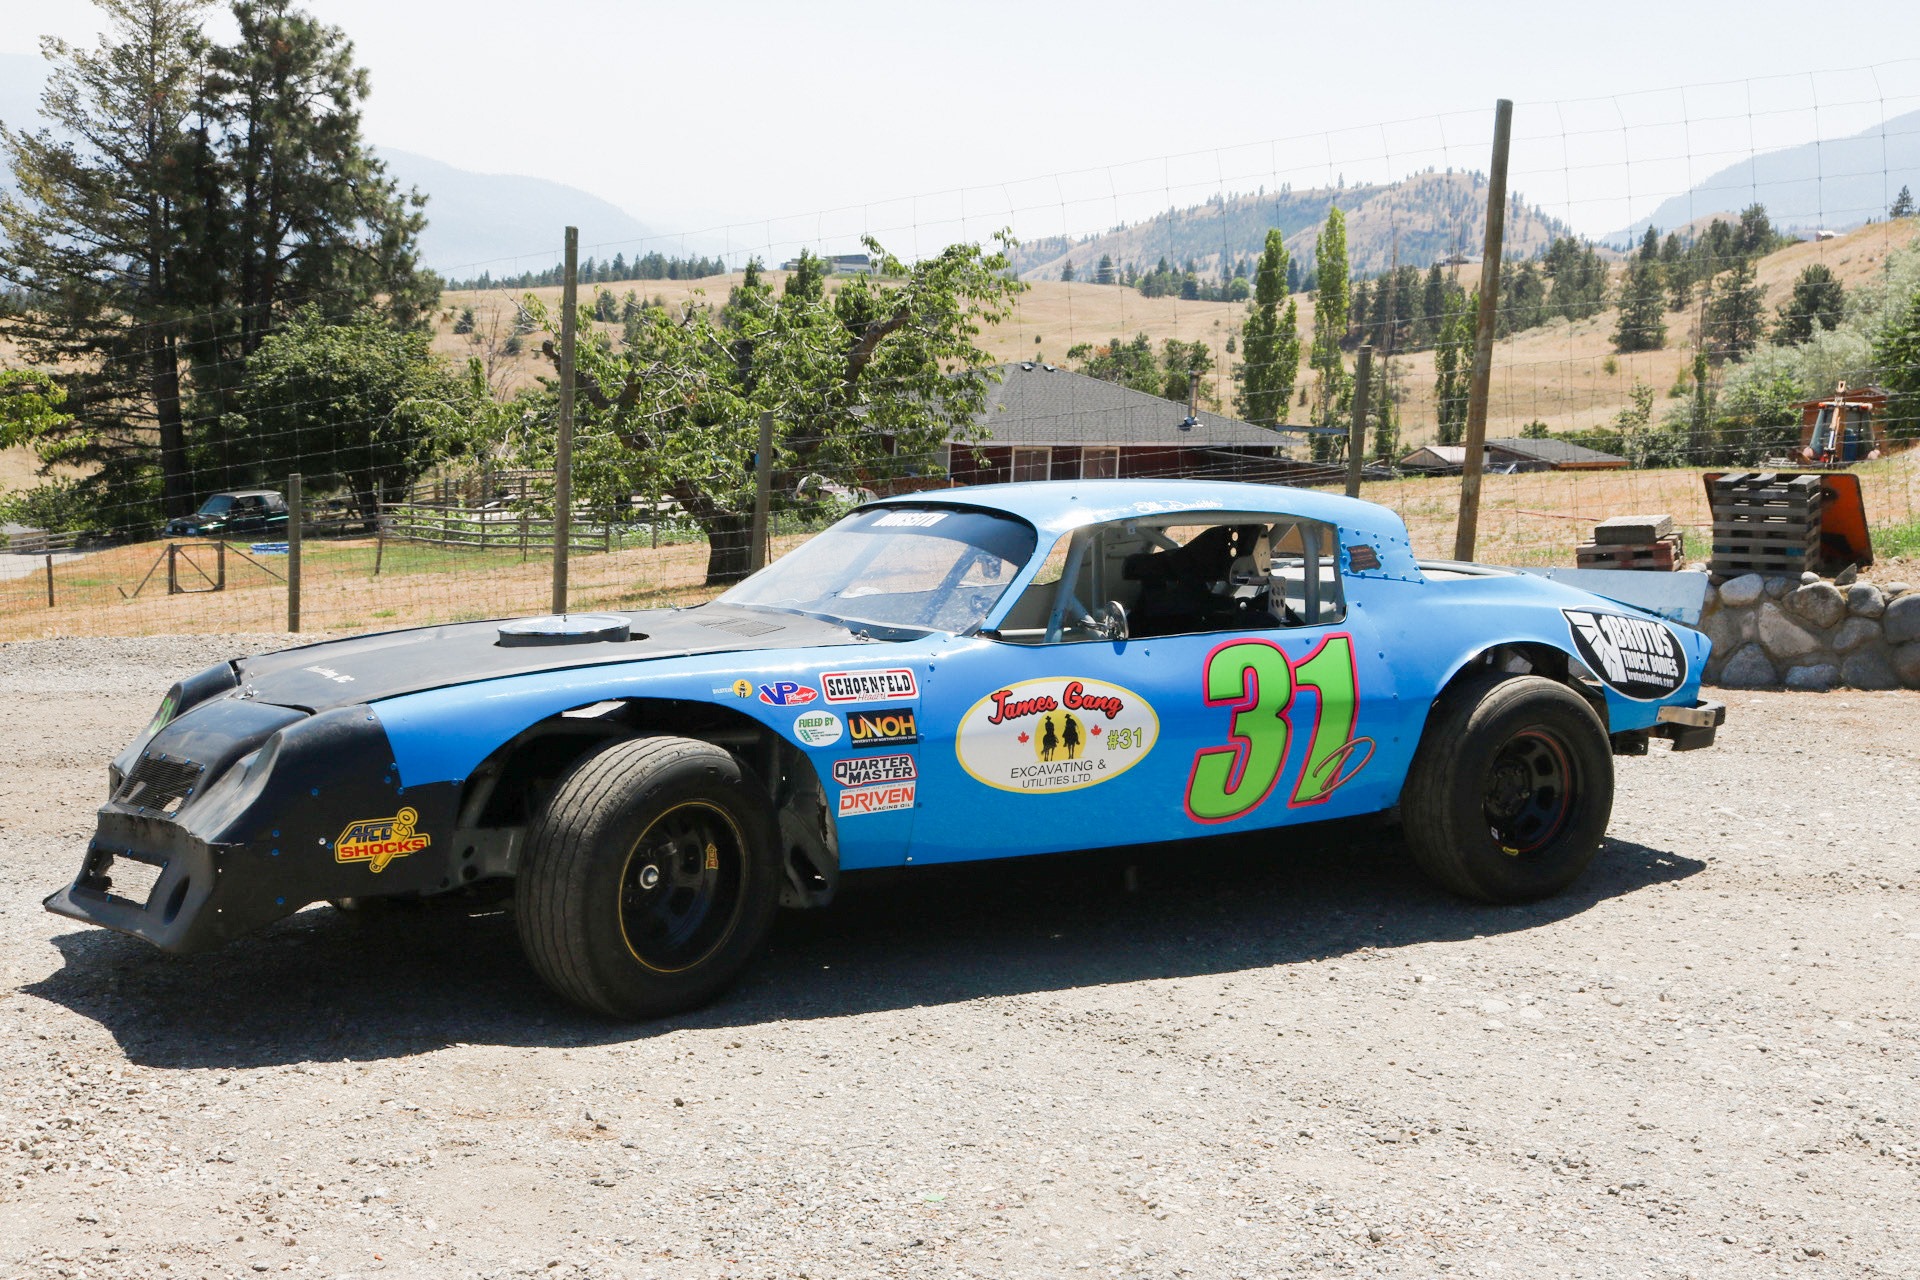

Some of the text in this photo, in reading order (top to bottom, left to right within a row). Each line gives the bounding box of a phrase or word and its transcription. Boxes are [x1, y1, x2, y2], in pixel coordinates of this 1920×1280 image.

[1608, 615, 1674, 657] BRUTUS
[1620, 650, 1679, 677] TRUCK BODIES
[760, 682, 798, 705] VP
[828, 674, 911, 696] SCHOENFELD
[857, 691, 887, 702] Headers
[988, 681, 1124, 725] James Gang
[798, 717, 834, 728] FUELED BY
[848, 714, 917, 739] UNOH
[1184, 632, 1360, 824] 31
[1107, 727, 1142, 750] #31
[835, 757, 910, 778] QUARTER
[848, 767, 913, 784] MASTER
[1010, 759, 1107, 779] EXCAVATING &
[1022, 773, 1093, 789] UTILITIES LTD.
[840, 786, 914, 812] DRIVEN
[872, 804, 898, 812] RACING
[340, 839, 425, 858] SHOCKS
